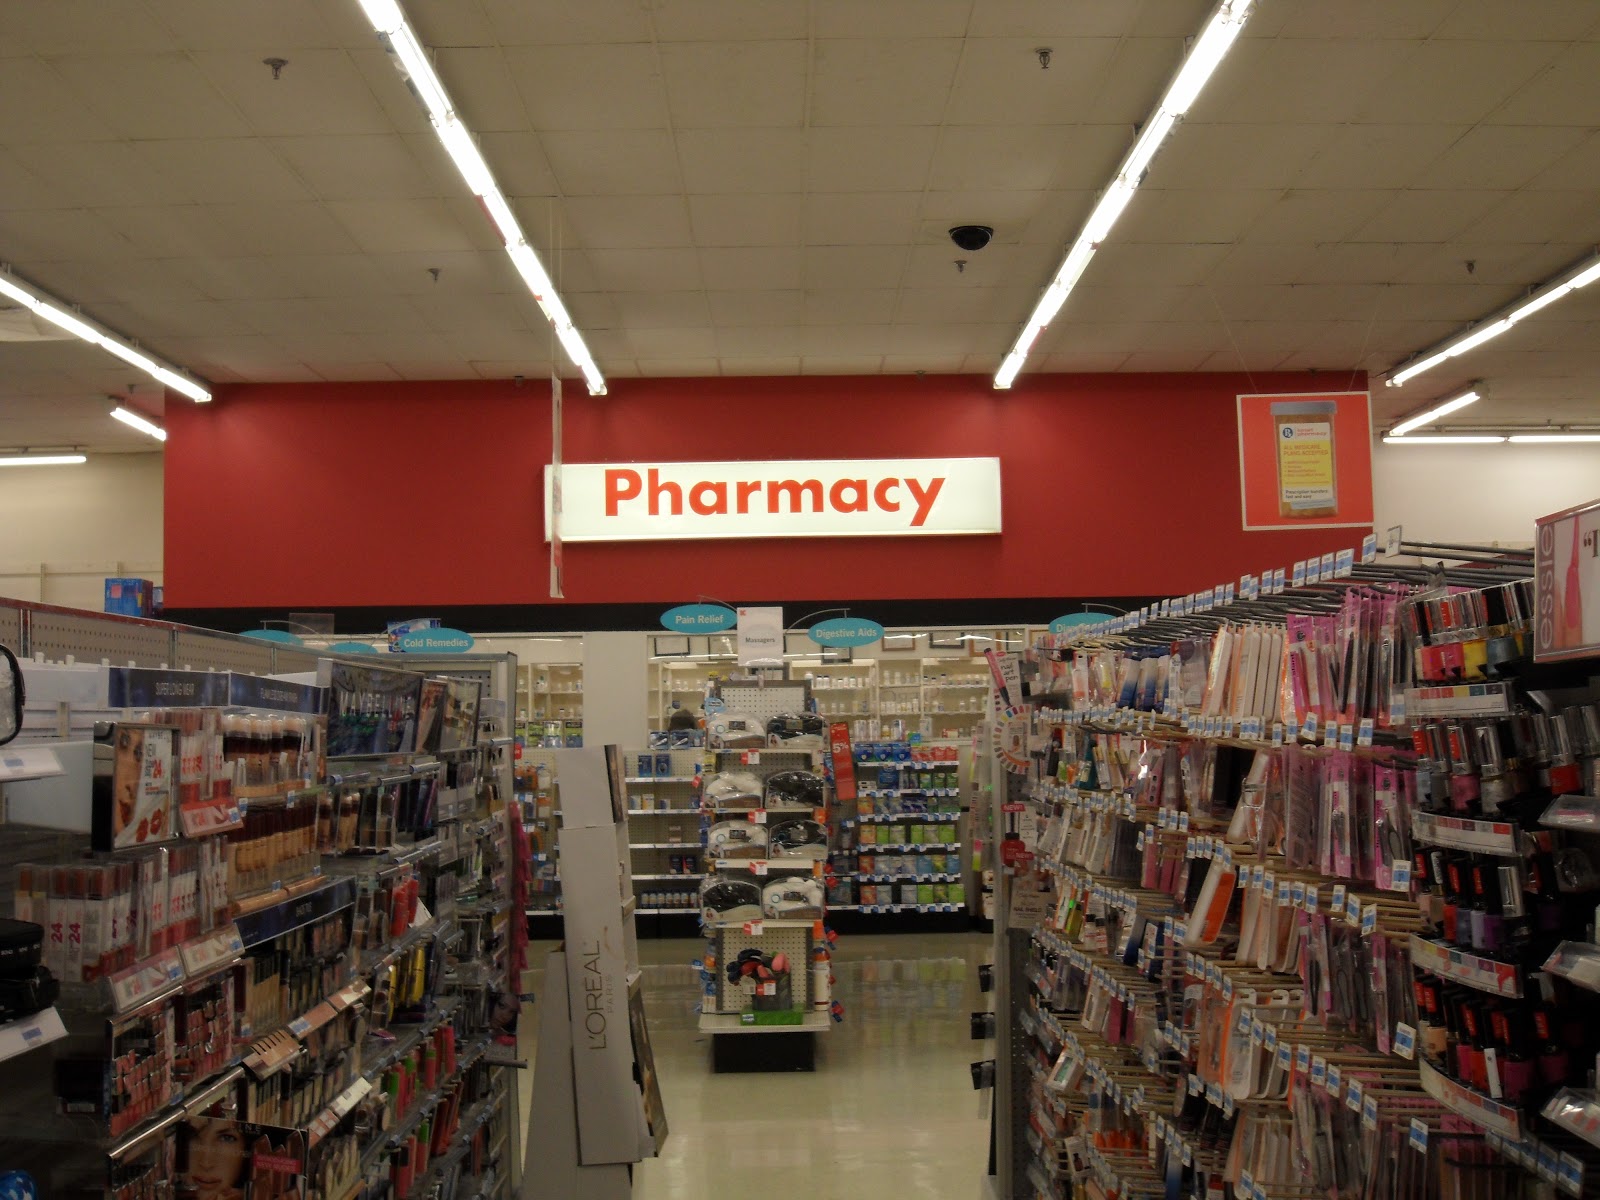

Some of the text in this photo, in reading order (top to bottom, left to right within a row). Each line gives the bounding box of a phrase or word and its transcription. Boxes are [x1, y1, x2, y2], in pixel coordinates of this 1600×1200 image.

[605, 468, 945, 526] Pharmacy
[1540, 525, 1554, 649] essie
[675, 614, 724, 624] Pain Relief
[745, 636, 776, 644] Massagers
[815, 627, 877, 640] Digestive Aids
[404, 638, 469, 648] Cold Remedies
[1000, 662, 1014, 670] nail
[1003, 804, 1024, 812] NEW!
[51, 922, 63, 943] 24
[69, 922, 81, 944] 24
[583, 940, 607, 1050] L'OREAL
